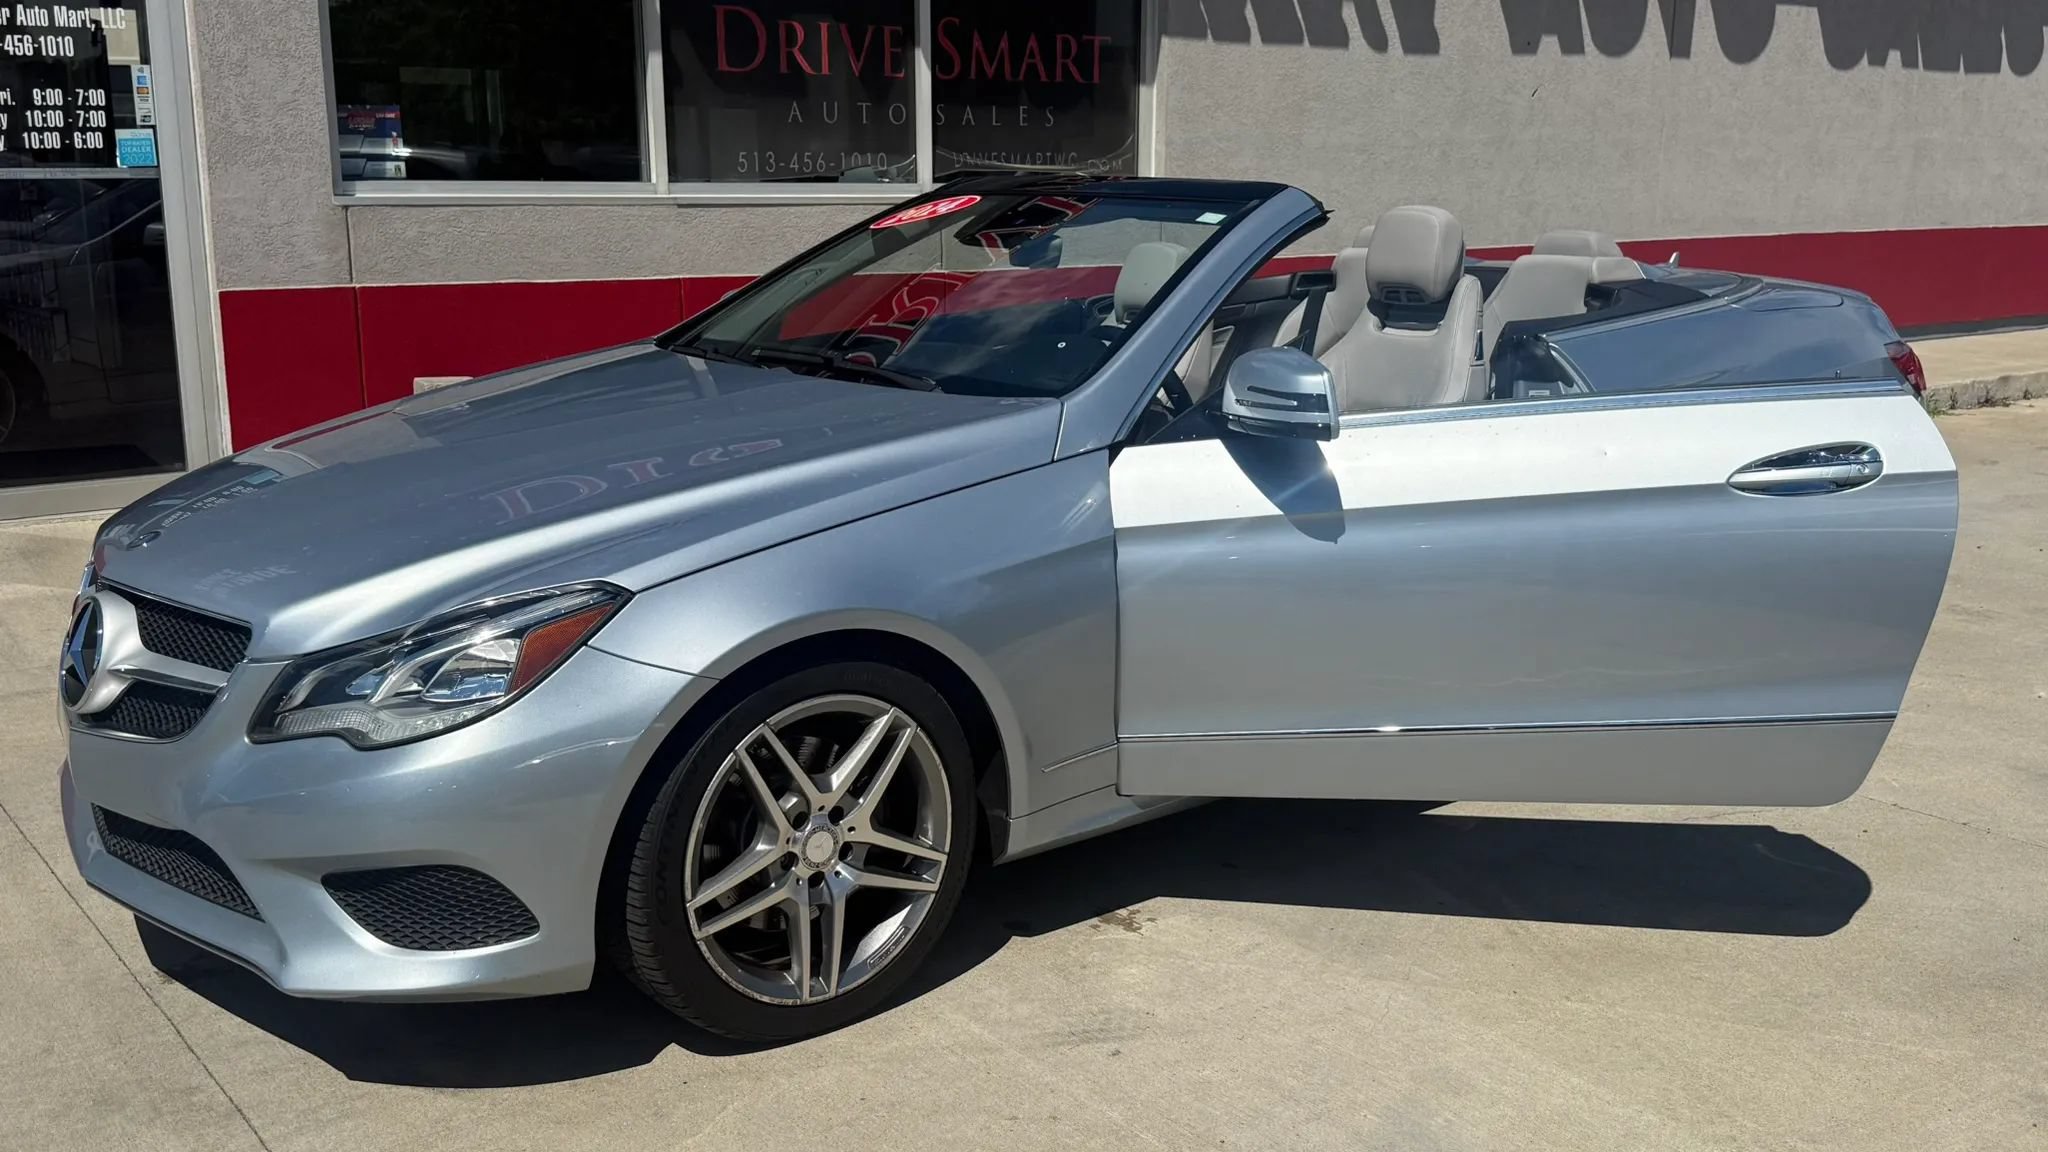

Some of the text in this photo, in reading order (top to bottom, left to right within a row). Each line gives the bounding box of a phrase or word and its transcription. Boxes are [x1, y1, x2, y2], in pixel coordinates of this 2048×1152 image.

[16, 3, 49, 27] Auto
[53, 5, 96, 32] Mart,
[100, 7, 126, 29] LLC
[33, 88, 64, 106] 9:00
[75, 89, 106, 106] 7:00
[25, 110, 64, 127] 10:00
[76, 110, 106, 127] 7:00
[787, 100, 1055, 127] AUTO SALES
[22, 131, 61, 149] 10:00
[74, 131, 103, 149] 6:00
[121, 153, 153, 165] 2022
[736, 151, 888, 174] 513-456-1010
